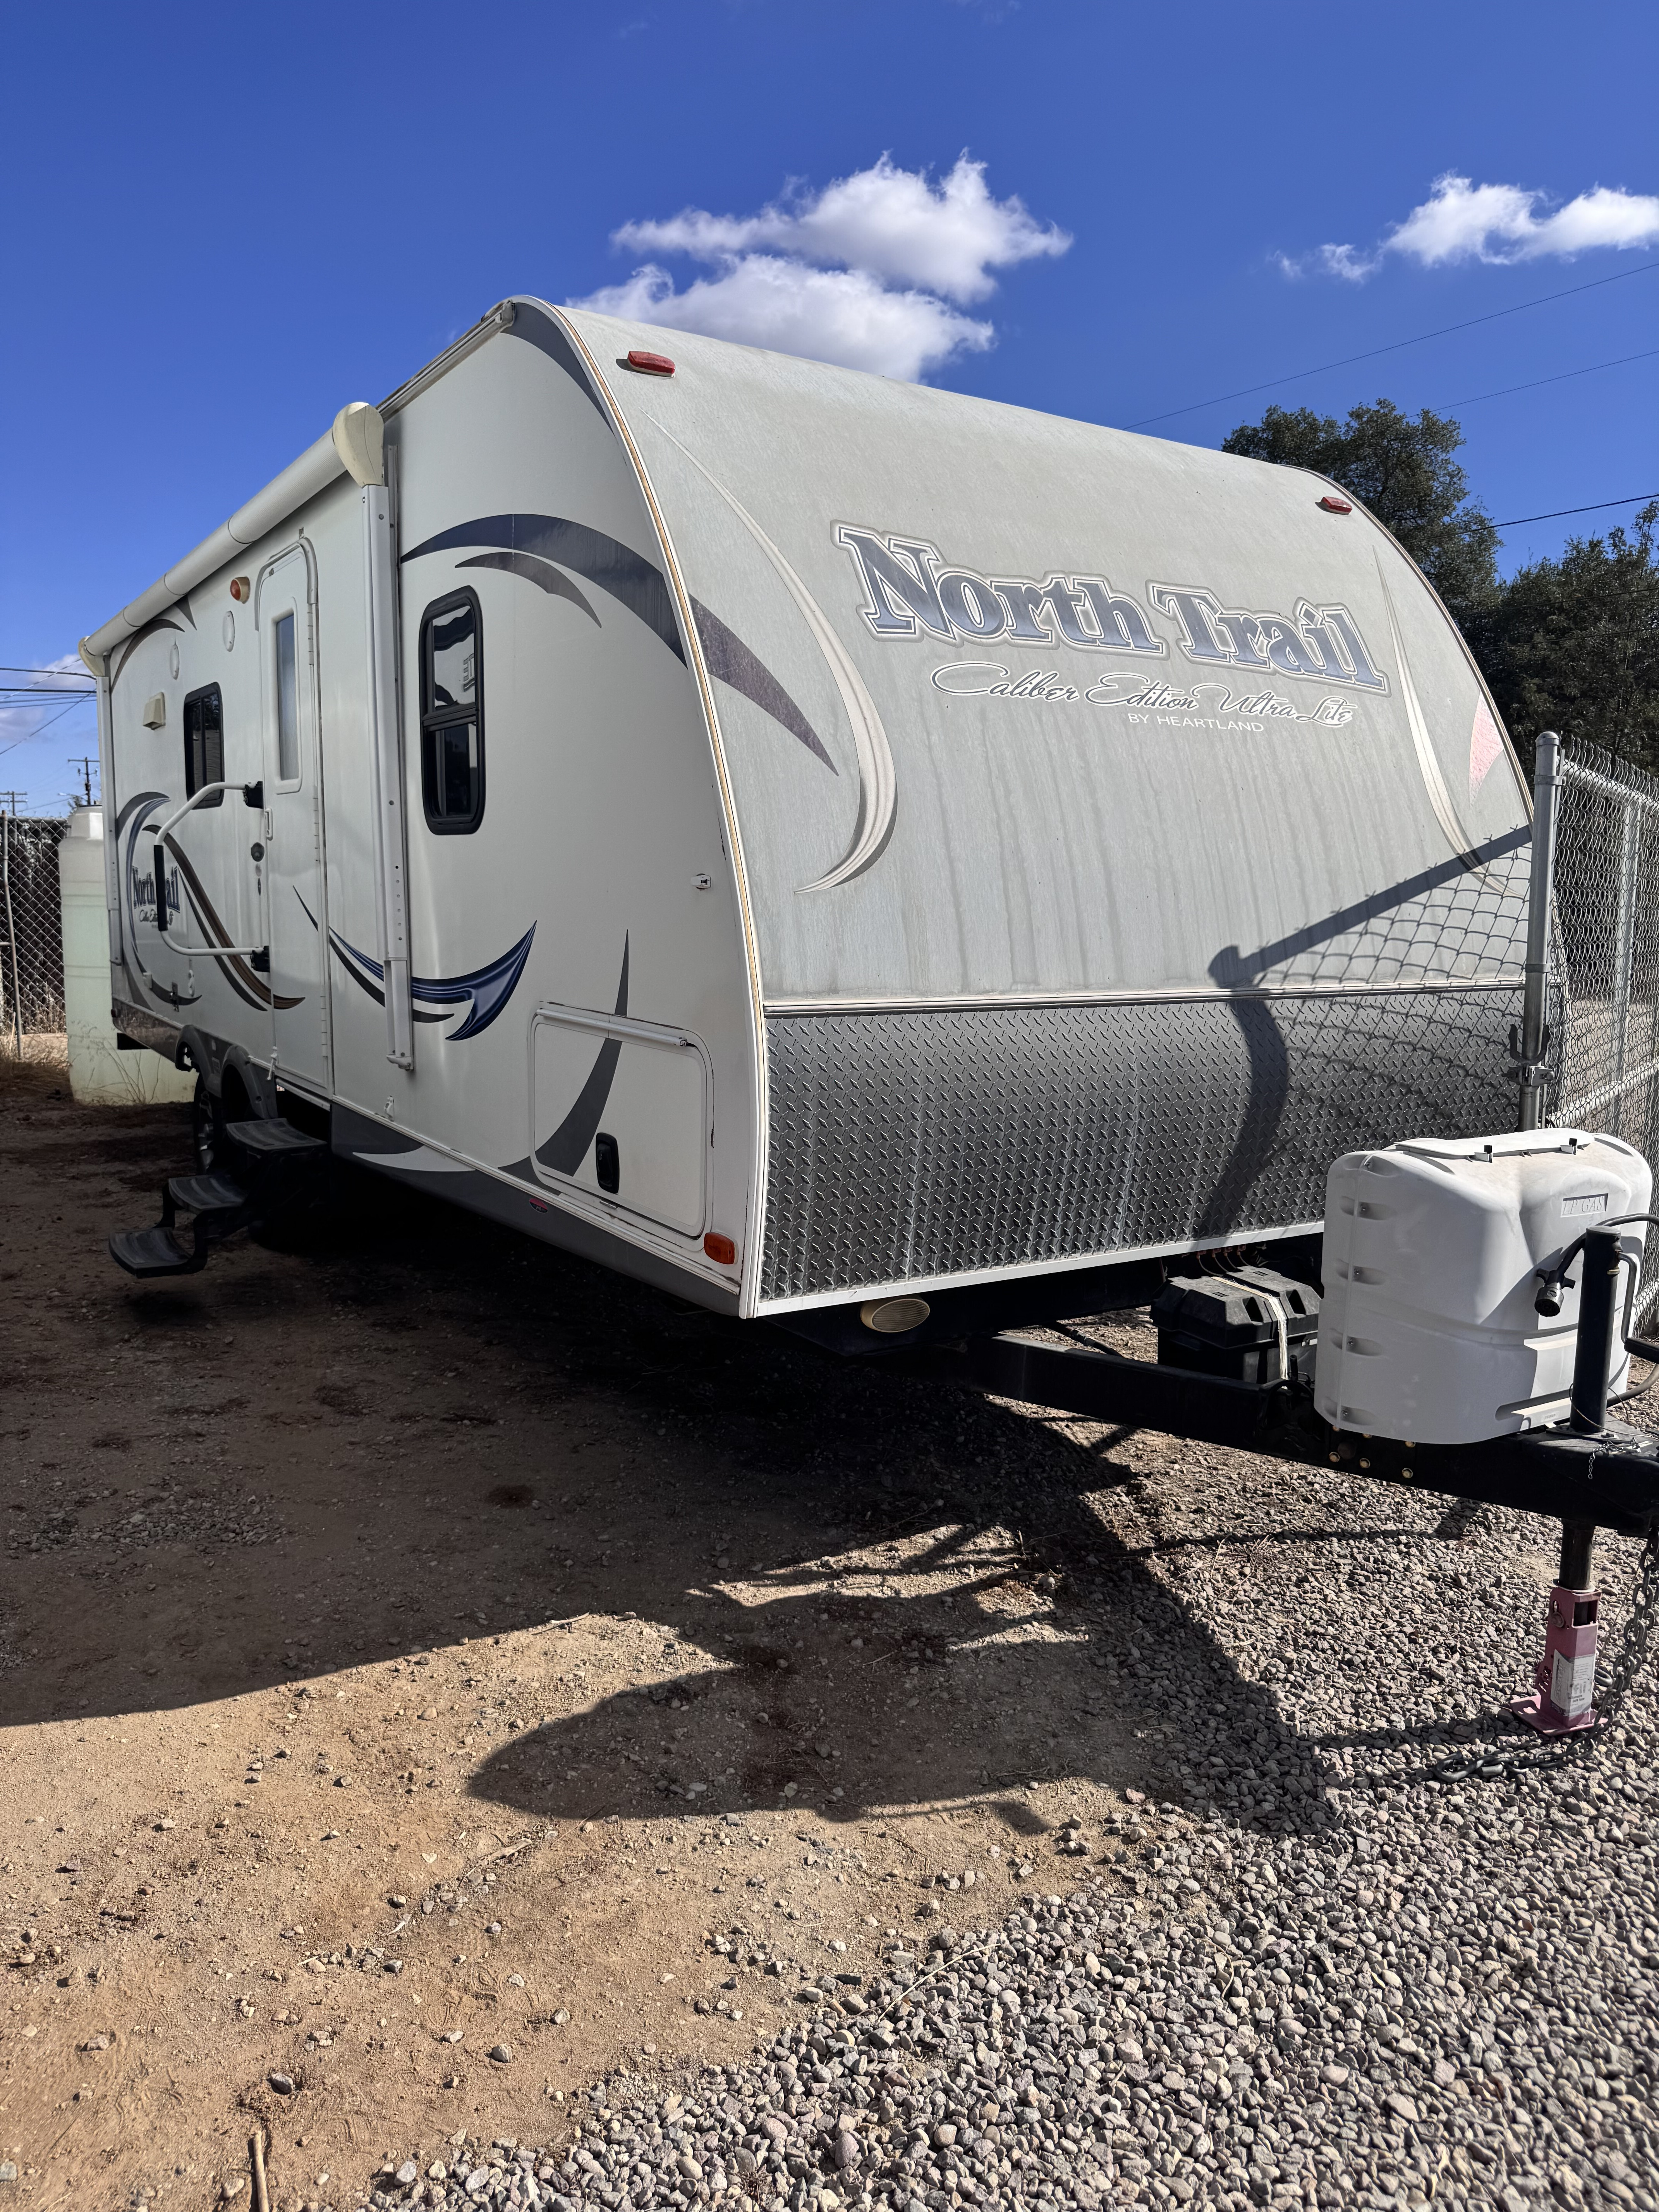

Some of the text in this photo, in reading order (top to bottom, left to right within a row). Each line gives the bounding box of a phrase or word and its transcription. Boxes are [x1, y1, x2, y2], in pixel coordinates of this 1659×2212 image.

[836, 523, 1388, 693] North Trail
[931, 661, 1358, 728] Caliber Edition Ultra Lite
[1128, 713, 1264, 732] BY HEARTLAND
[132, 866, 156, 910] North
[1562, 1195, 1604, 1215] LP GAS
